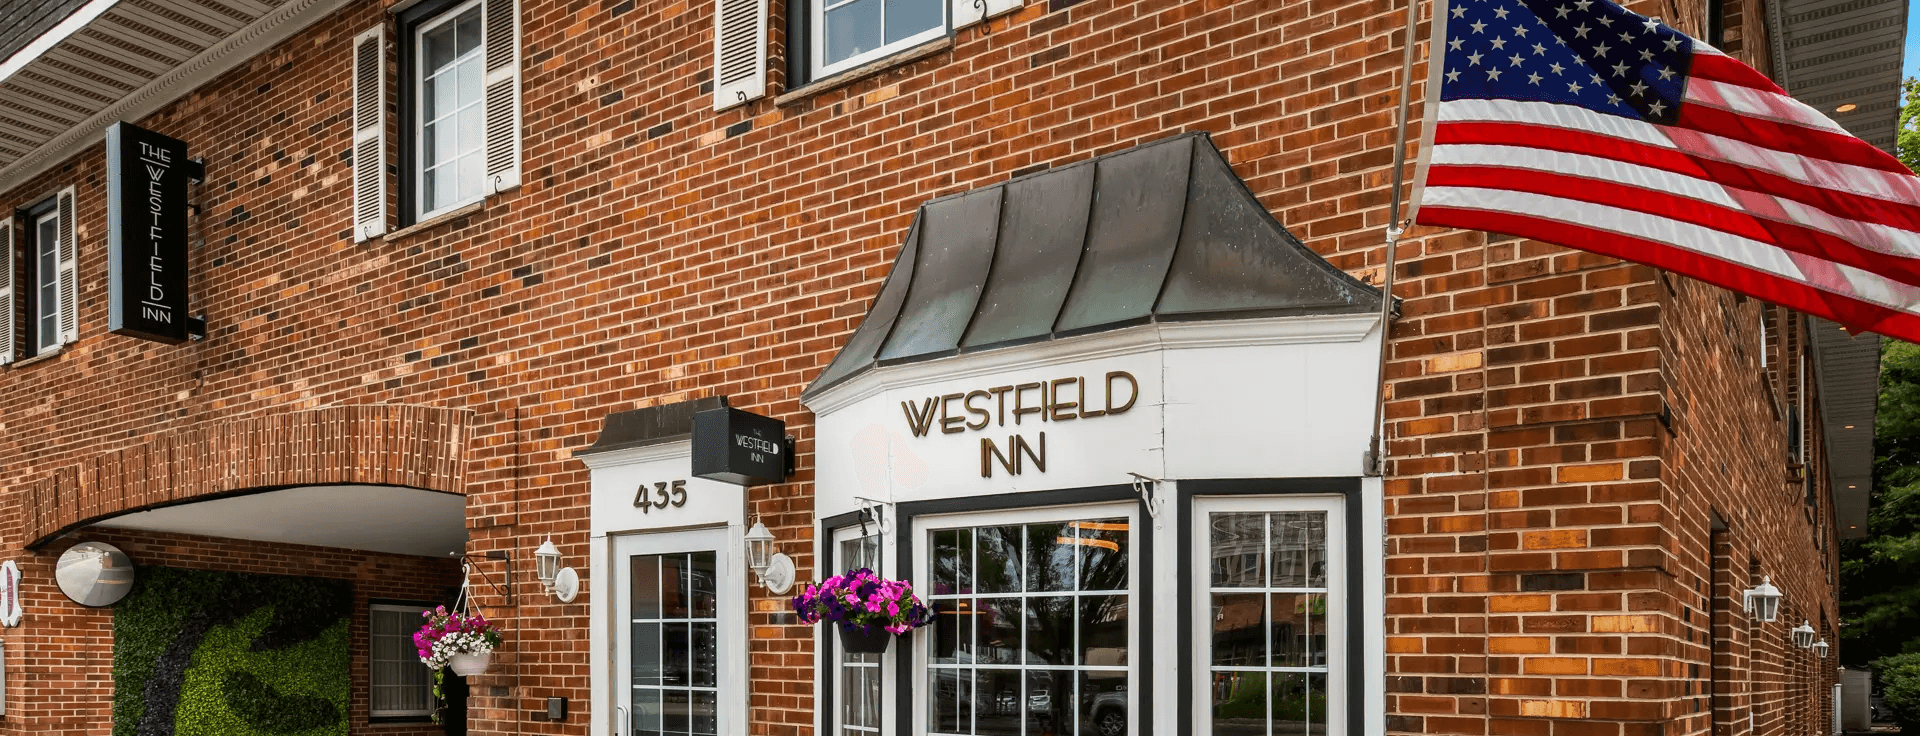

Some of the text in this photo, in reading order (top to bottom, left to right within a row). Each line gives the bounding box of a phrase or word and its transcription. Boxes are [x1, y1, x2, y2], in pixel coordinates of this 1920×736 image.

[139, 142, 171, 162] THE
[146, 164, 165, 301] WESTFIELD
[142, 306, 171, 324] INN
[900, 370, 1138, 437] WESTFIELD
[735, 433, 779, 455] WESTFIELD
[750, 452, 764, 464] INN
[980, 431, 1046, 478] INN
[633, 479, 687, 514] 435
